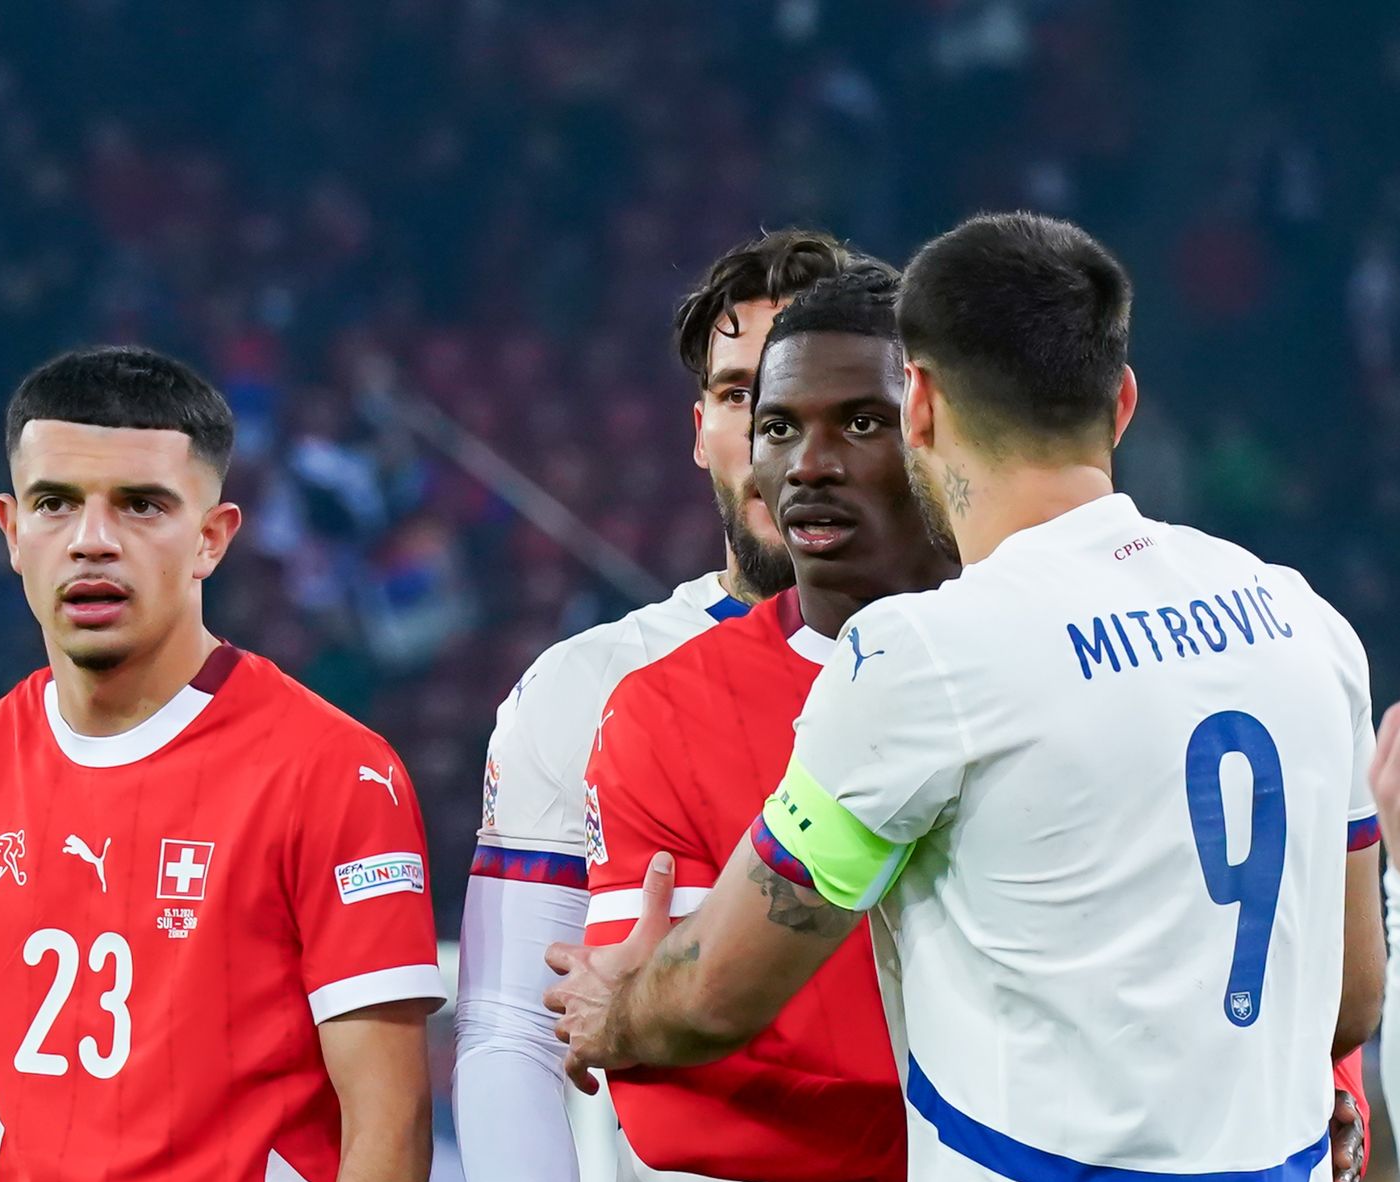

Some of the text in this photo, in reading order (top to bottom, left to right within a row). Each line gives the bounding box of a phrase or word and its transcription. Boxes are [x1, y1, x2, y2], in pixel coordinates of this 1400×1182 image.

[1066, 574, 1294, 681] MITROVIĆ
[338, 863, 363, 877] UEFA
[1185, 710, 1287, 1028] 9
[156, 917, 173, 929] SUI
[13, 928, 134, 1079] 23
